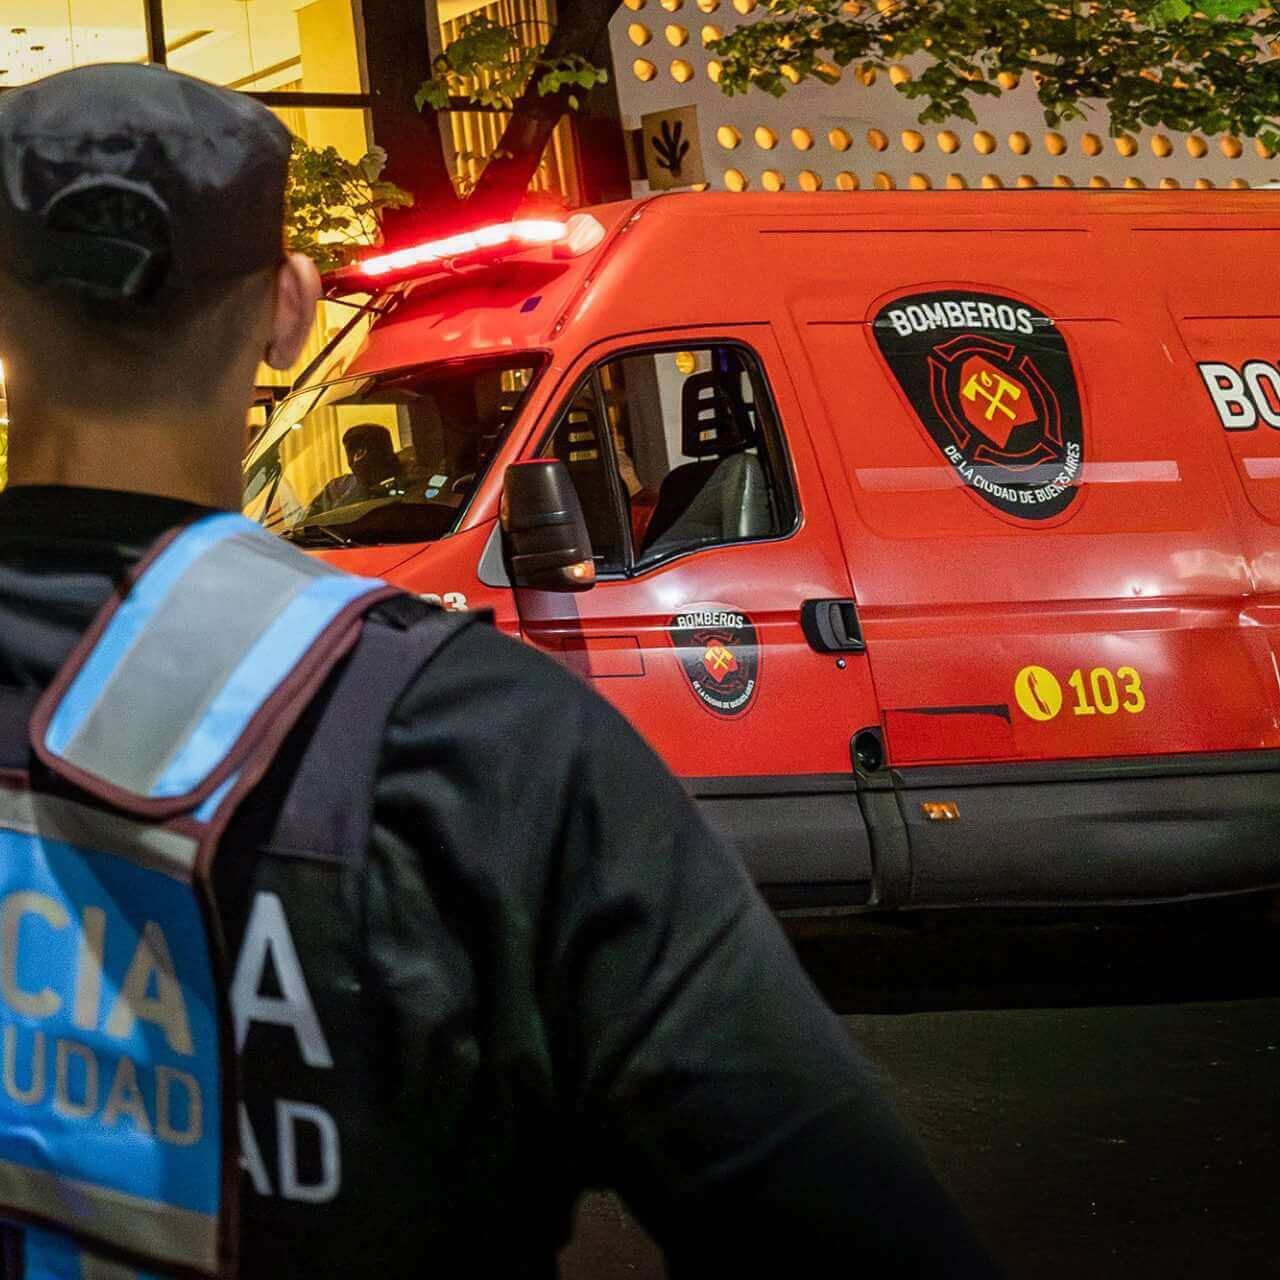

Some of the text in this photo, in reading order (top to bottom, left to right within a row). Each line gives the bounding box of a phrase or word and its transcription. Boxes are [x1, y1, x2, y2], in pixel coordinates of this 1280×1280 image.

[888, 301, 1034, 336] BOMBEROS
[944, 445, 962, 464] DE
[958, 461, 975, 480] LA
[973, 475, 1017, 502] CIUDAD
[1020, 490, 1036, 504] DE
[1063, 441, 1080, 477] AIRES
[677, 612, 744, 629] BOMBEROS
[1068, 666, 1146, 715] 103
